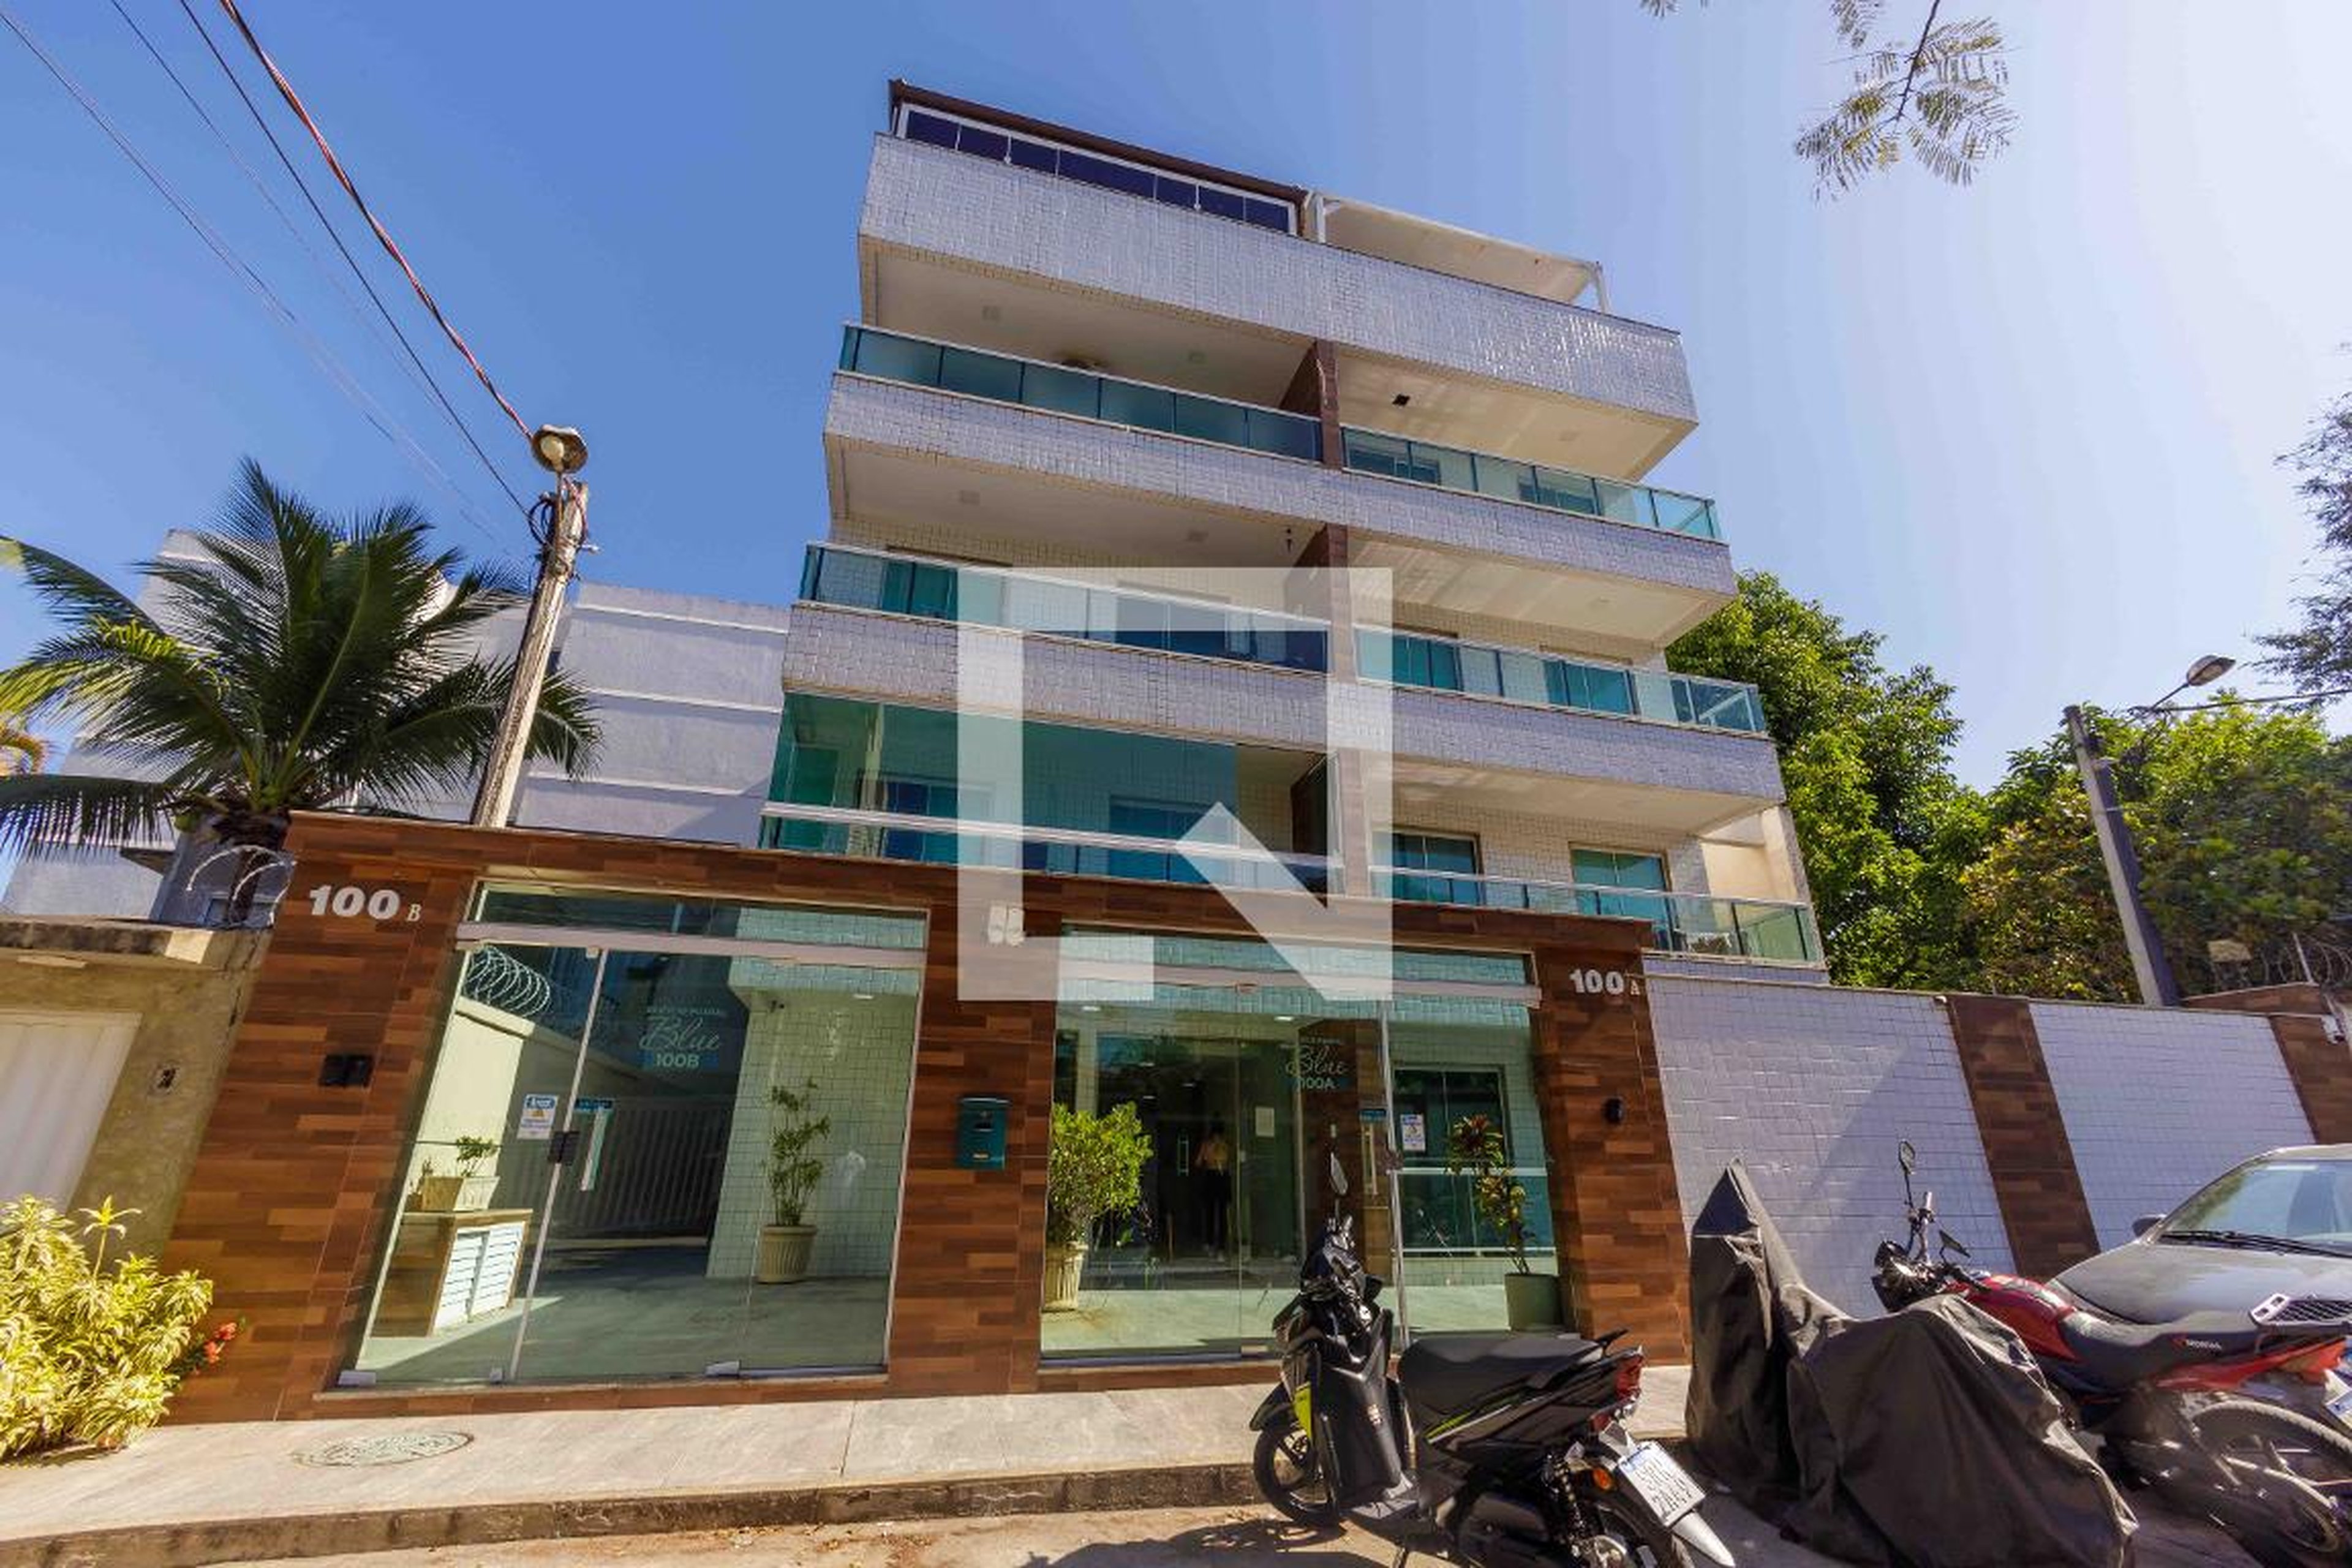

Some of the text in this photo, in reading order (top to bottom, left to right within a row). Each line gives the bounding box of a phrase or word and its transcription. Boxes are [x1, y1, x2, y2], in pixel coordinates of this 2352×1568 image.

[310, 885, 423, 922] 100 B
[1569, 969, 1640, 995] 100 A
[659, 1052, 700, 1068] 100B
